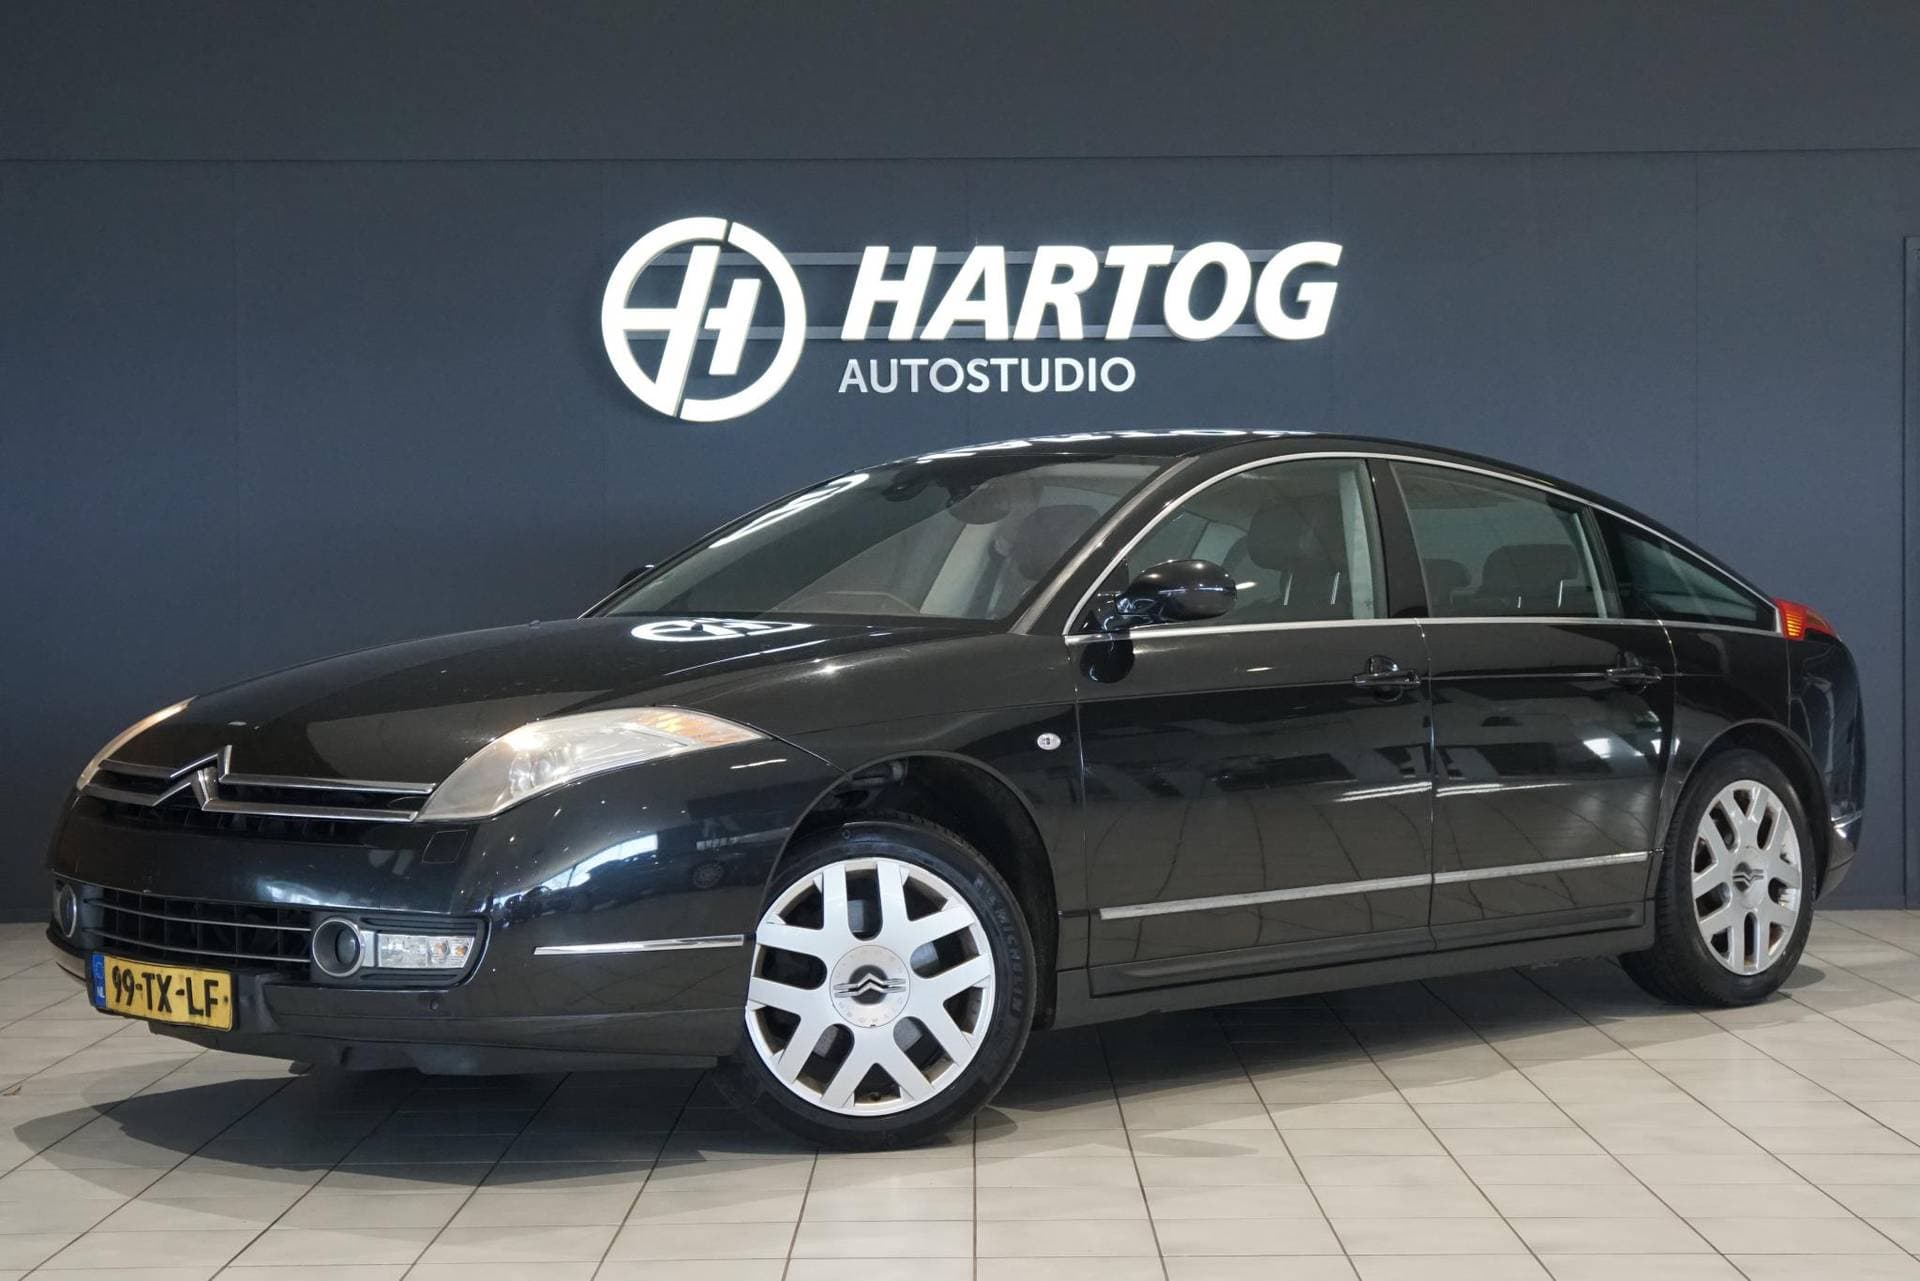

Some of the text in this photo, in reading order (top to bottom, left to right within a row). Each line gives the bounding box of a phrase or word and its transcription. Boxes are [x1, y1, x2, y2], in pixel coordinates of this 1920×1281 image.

[840, 241, 1343, 341] HARTOG
[838, 356, 1137, 395] AUTOSTUDIO
[111, 965, 219, 1018] 99-TX-LF
